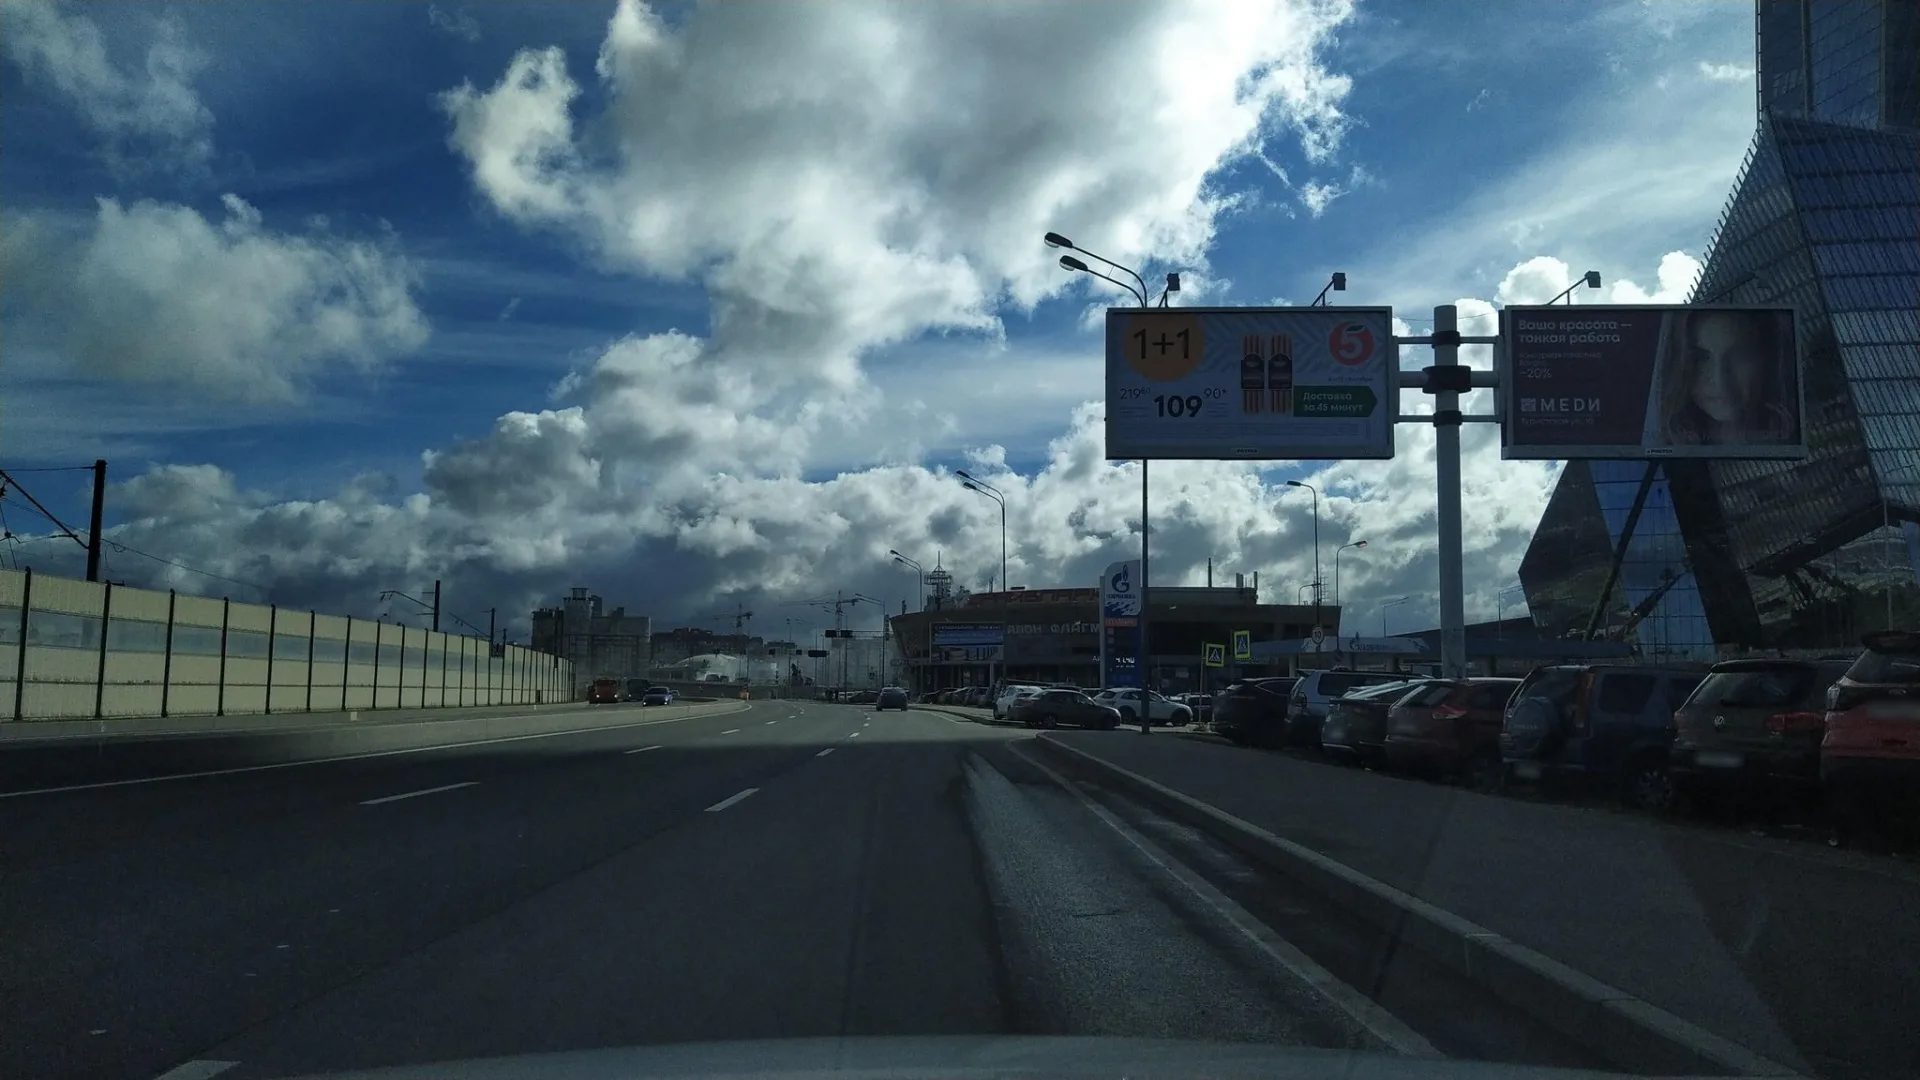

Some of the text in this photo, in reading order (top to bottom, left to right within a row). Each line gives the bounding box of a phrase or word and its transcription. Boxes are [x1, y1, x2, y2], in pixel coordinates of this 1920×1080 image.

[1518, 319, 1556, 330] Ваша
[1559, 320, 1618, 332] красота
[1133, 327, 1190, 360] 1+1
[1518, 332, 1620, 345] тонкая работа
[1302, 392, 1353, 402] Доставка
[1153, 394, 1203, 418] 109
[1331, 403, 1365, 412] минут
[1050, 622, 1101, 635] ФЛАГМ
